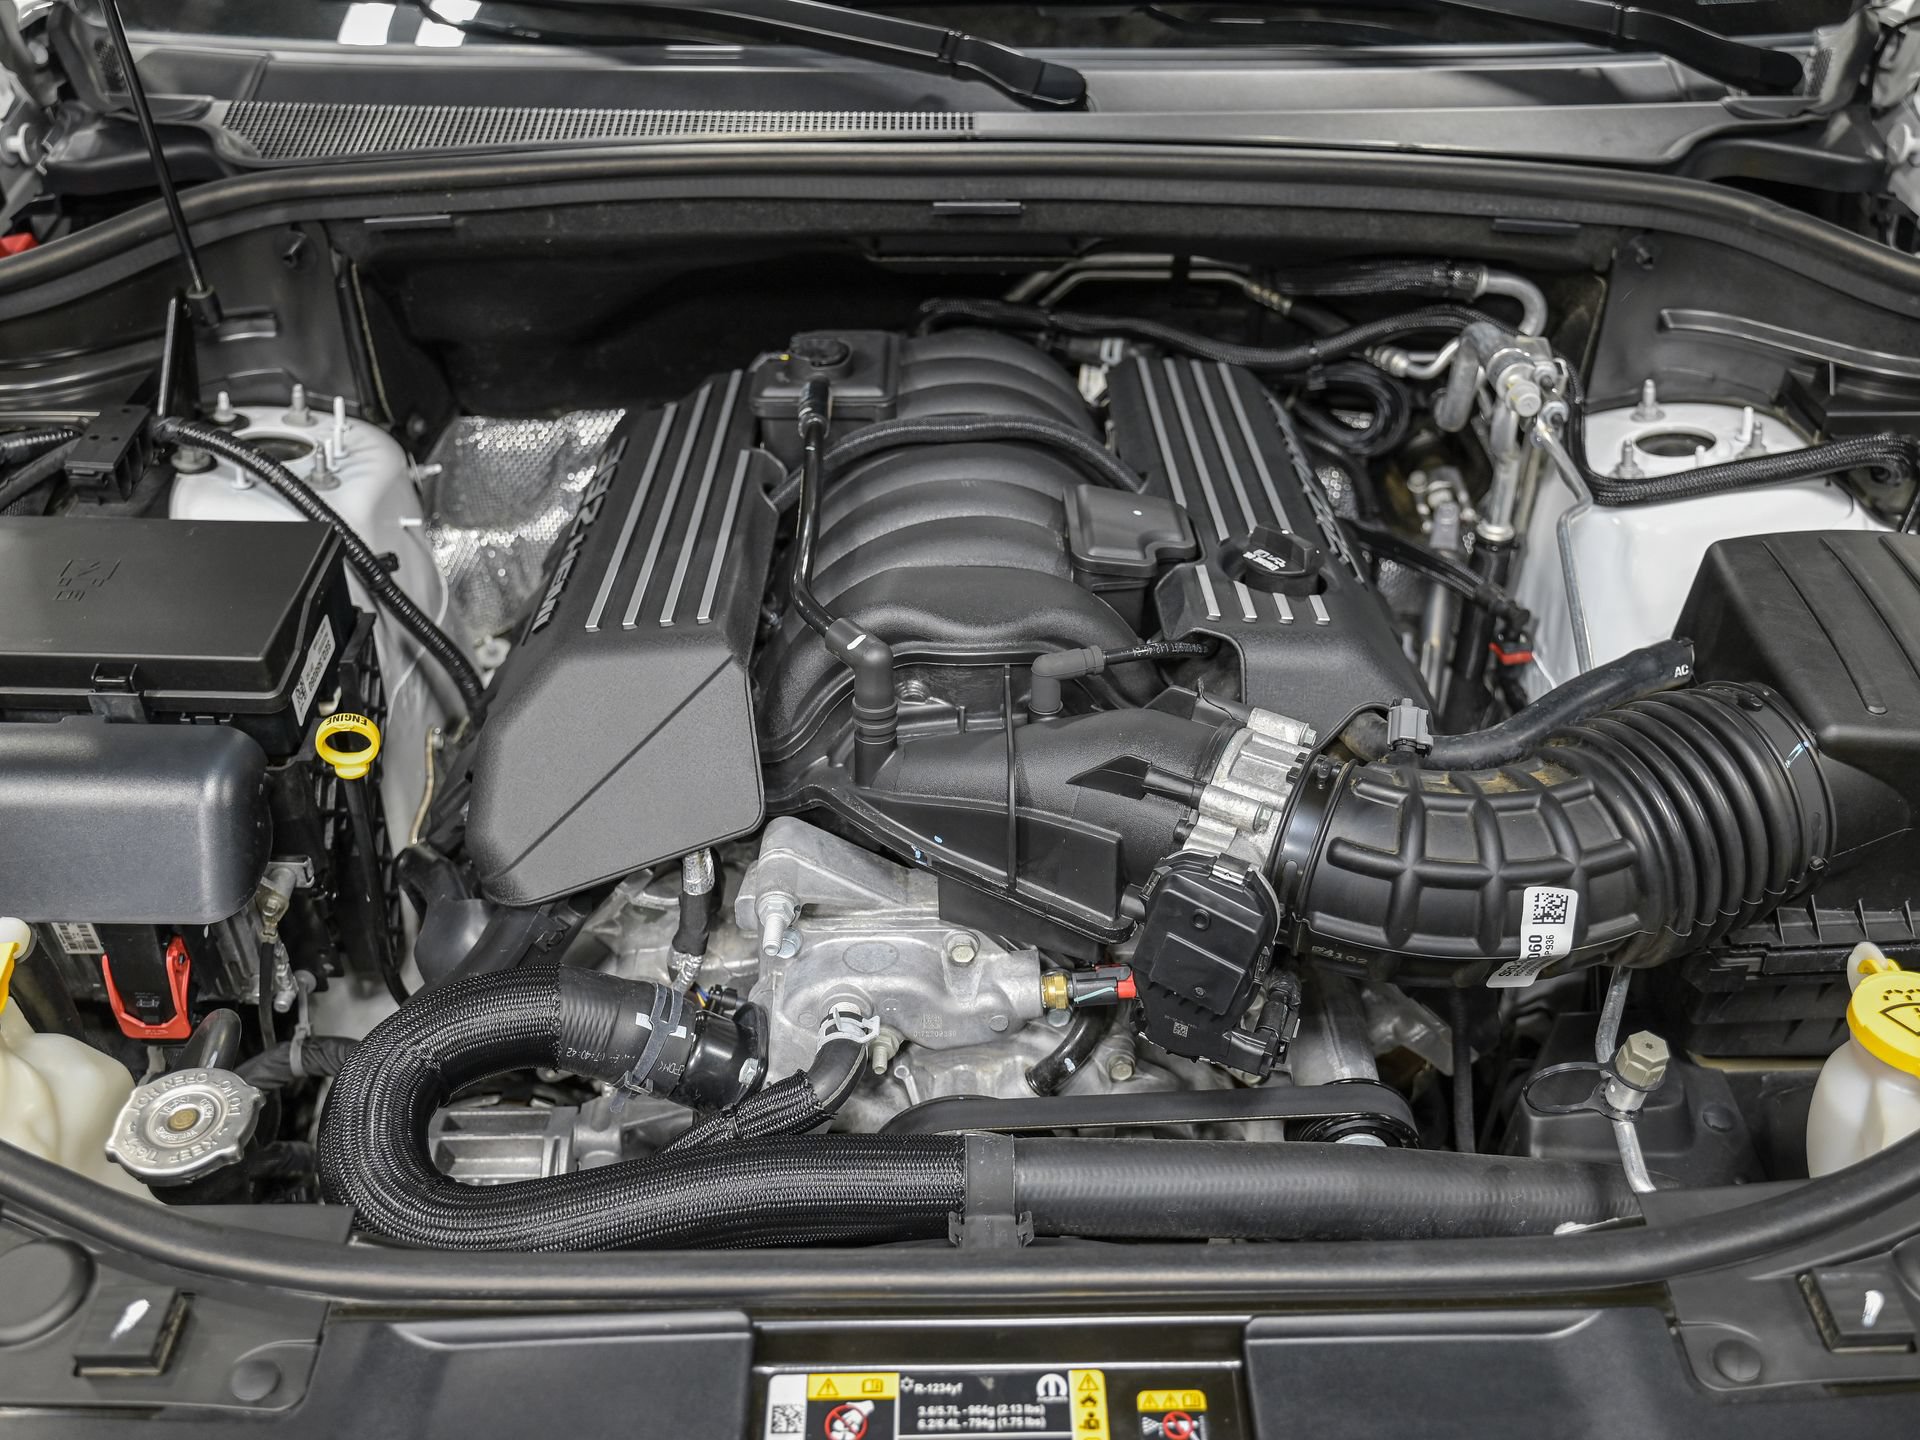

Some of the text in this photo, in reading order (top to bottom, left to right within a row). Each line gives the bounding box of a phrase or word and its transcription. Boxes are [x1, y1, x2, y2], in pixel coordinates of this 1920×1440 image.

[531, 436, 628, 633] 392 HEMI
[1674, 664, 1689, 678] AC
[326, 714, 368, 726] ENGINE
[162, 1073, 209, 1091] OPEN
[169, 1136, 218, 1163] KEEP
[914, 1382, 963, 1396] R-1234yf
